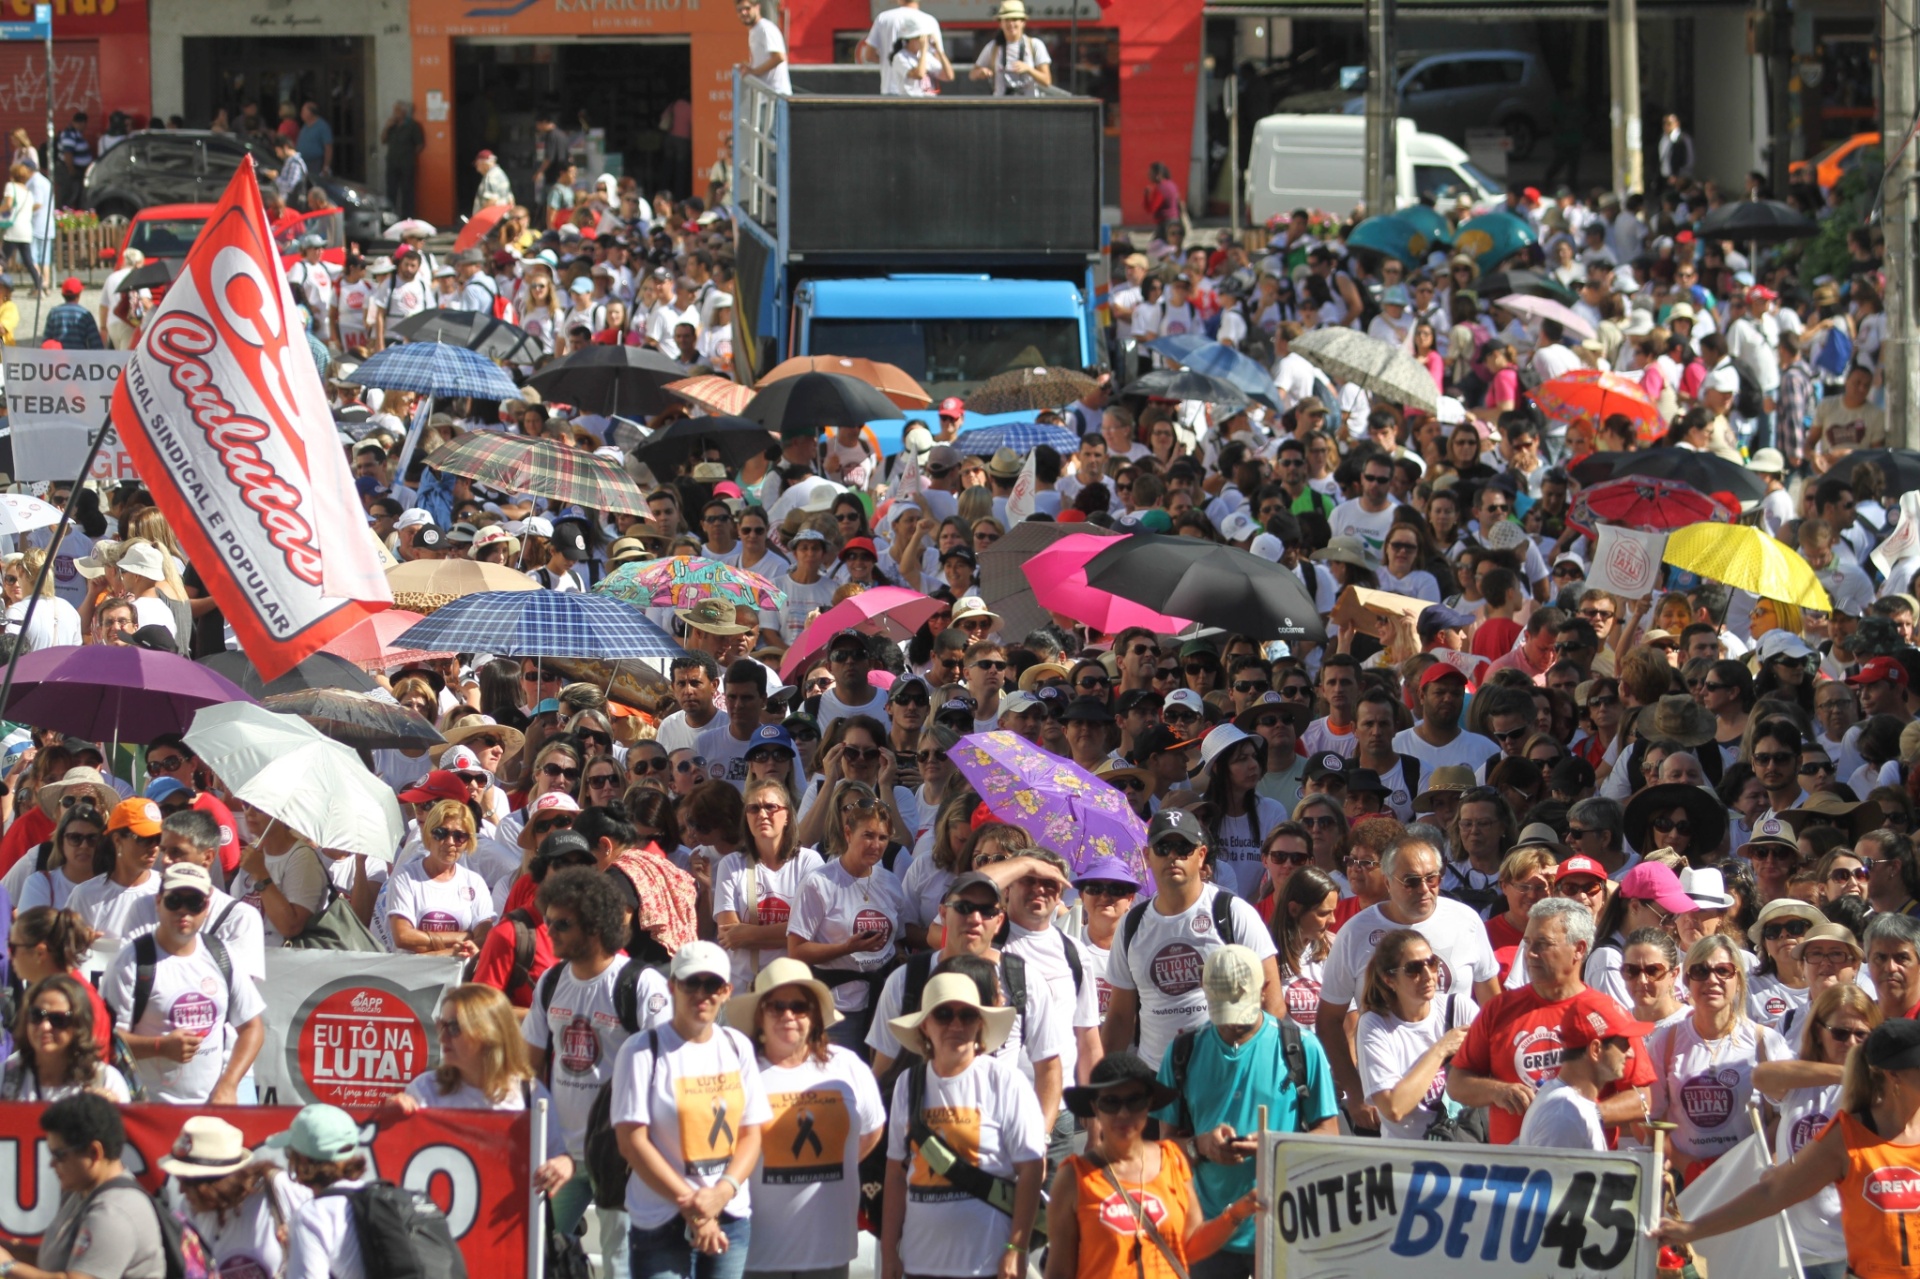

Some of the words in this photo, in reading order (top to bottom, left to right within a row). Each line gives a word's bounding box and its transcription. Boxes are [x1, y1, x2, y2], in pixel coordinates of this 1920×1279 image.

[8, 394, 86, 414] TEBAS
[147, 309, 323, 586] Conlutas
[151, 414, 208, 510] SINDICAL
[206, 513, 225, 529] E
[219, 529, 291, 633] POPULAR
[1155, 962, 1168, 973] EU
[1183, 957, 1199, 968] NA
[1156, 967, 1200, 984] LUTA!
[174, 1013, 214, 1028] LUTA!
[313, 1024, 343, 1047] EU
[349, 1021, 378, 1049] TÔ
[384, 1028, 414, 1050] NA
[313, 1047, 414, 1080] LUTA!
[1523, 1051, 1561, 1069] GREV
[697, 1074, 727, 1086] LUTO
[782, 1091, 817, 1101] LUTO
[1684, 1091, 1698, 1100] EU
[1699, 1088, 1712, 1100] TÔ
[1713, 1090, 1728, 1100] NA
[1687, 1100, 1729, 1113] LUTA!
[767, 1174, 786, 1183] N.S.
[789, 1172, 842, 1183] UMUARAMA
[1277, 1162, 1397, 1244] ONTEM
[1389, 1160, 1553, 1263] BETO
[1541, 1170, 1637, 1271] 45
